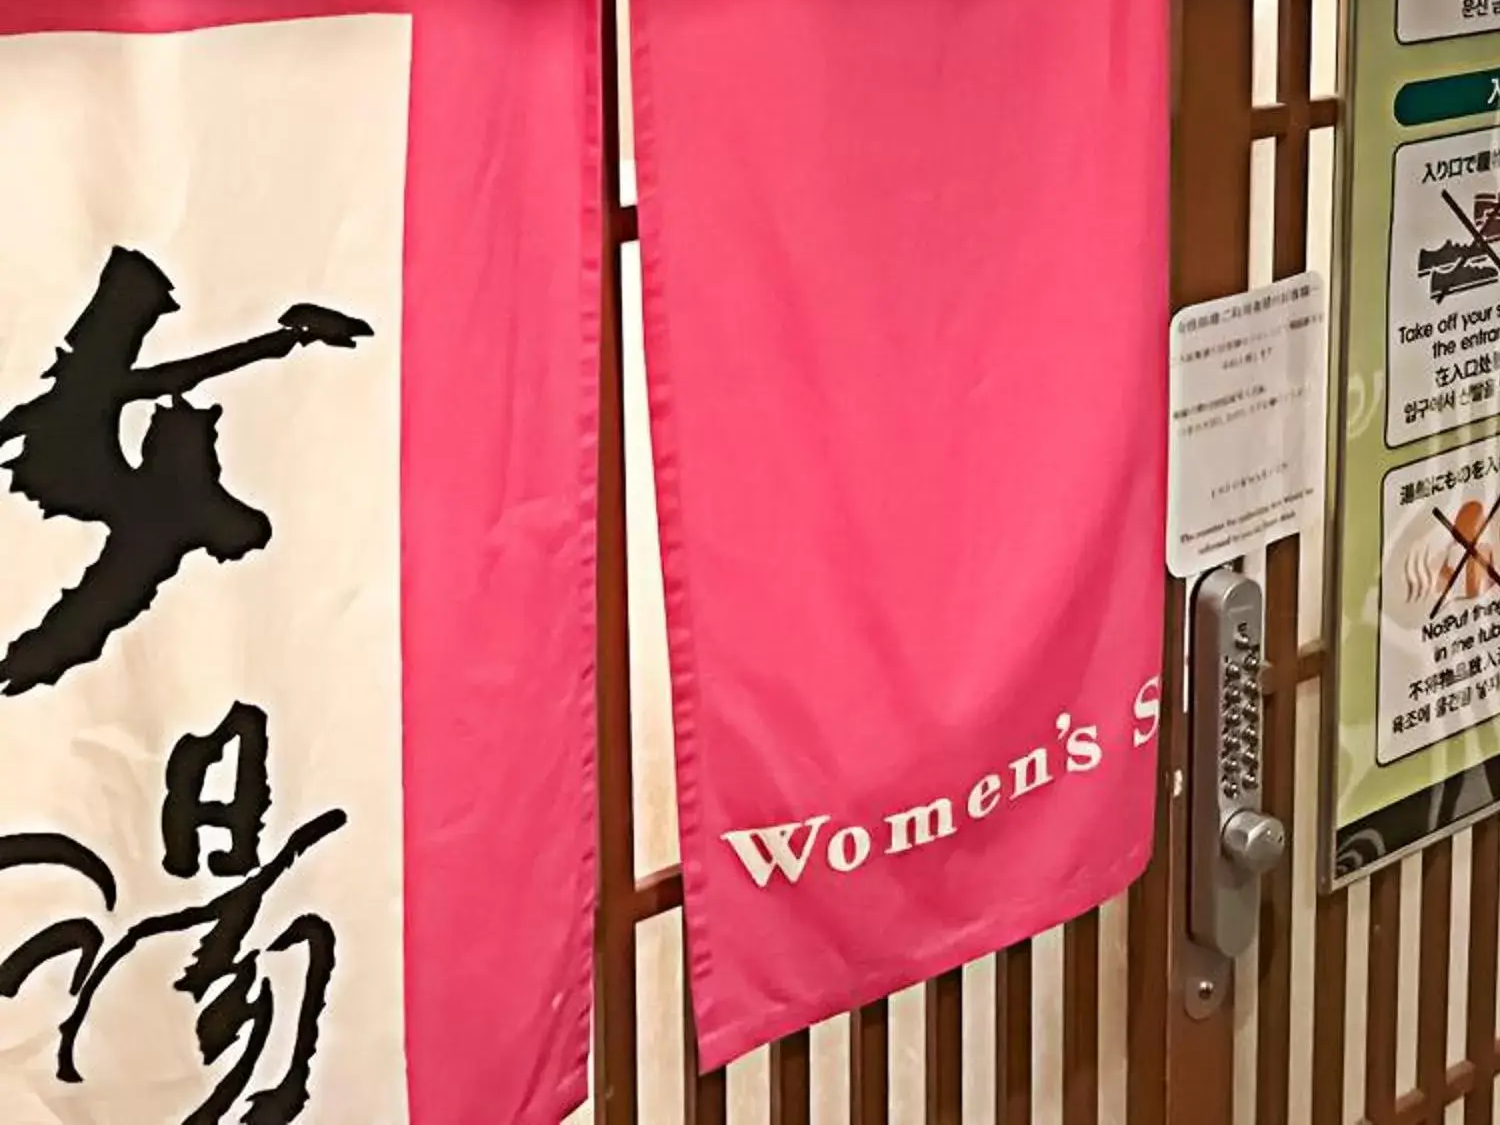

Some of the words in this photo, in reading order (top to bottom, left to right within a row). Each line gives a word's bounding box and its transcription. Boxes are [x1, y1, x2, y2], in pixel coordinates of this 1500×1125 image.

[1398, 322, 1433, 344] Take
[1437, 311, 1459, 334] off
[1461, 306, 1493, 331] your
[1432, 340, 1456, 359] the
[1434, 646, 1447, 663] in
[720, 712, 1103, 888] Women's
